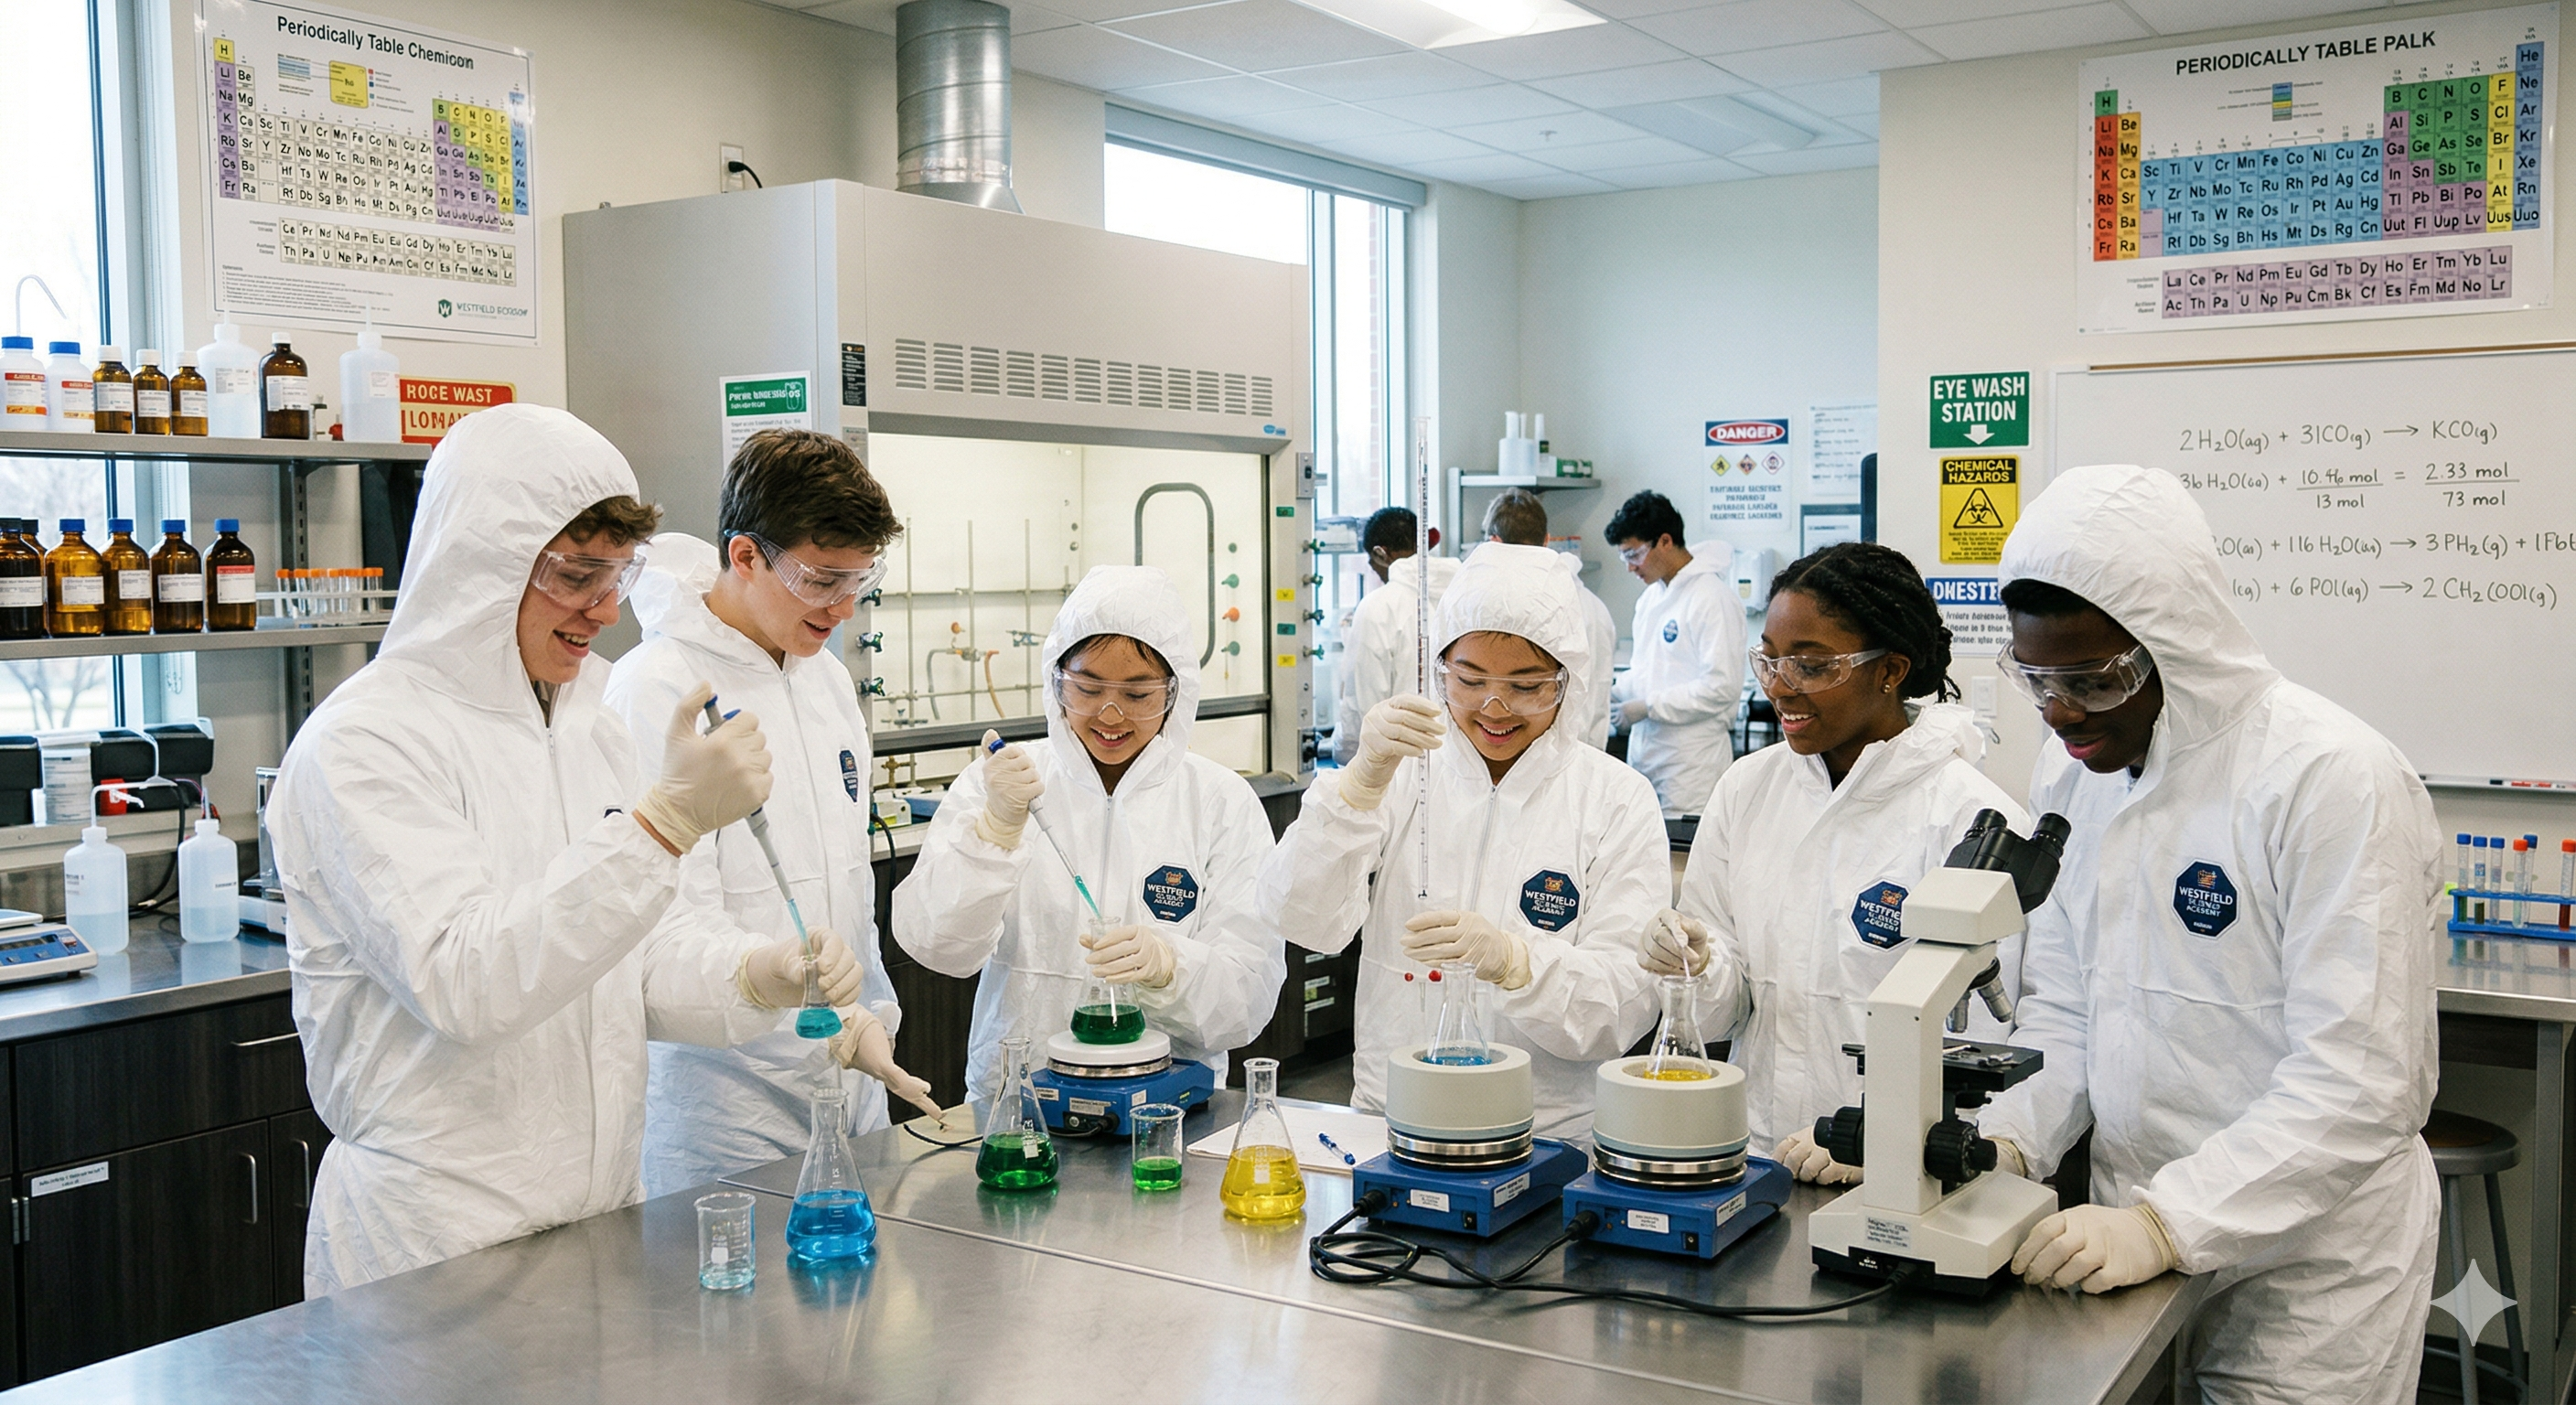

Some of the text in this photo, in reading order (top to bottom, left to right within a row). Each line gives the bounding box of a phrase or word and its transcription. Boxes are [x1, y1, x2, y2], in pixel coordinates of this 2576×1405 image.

[278, 16, 363, 49] Periodically
[368, 34, 404, 55] Table
[221, 45, 228, 55] H
[2176, 31, 2435, 75] PERIODICALLY TABLE PALK
[239, 71, 251, 81] Be
[2102, 50, 2538, 107] H He
[220, 90, 252, 106] Na Mg
[2121, 77, 2538, 131] Be B C N O F Ne
[223, 113, 327, 137] K Ti V Cr
[2098, 103, 2536, 156] Na Mg Al Si P S Cl Ar
[242, 139, 346, 161] Sr Y Zr Mo Tc
[2102, 130, 2536, 180] K Ca Sc Ti V Cr Mn Fe Co Ni Cu Zn Br Kr
[318, 170, 328, 180] W
[2098, 156, 2536, 205] Rb Sr Y Zr Nb Mo Tc Ru Rh Pd Ag Cd Sn Xe
[225, 181, 255, 193] Fr Ra
[2098, 182, 2536, 229] Cs Ba Hf Ta W Re Os Ir Pt Au Hg Pb Bi Po At Rn
[303, 227, 313, 236] Pr
[2099, 222, 2377, 253] Fr Ra Db Sg Bh Hs Mt Ds Rg Cn
[284, 246, 329, 259] Th Pa U
[2215, 253, 2506, 284] Pr Eu Ho Er Yb Lu
[2240, 279, 2505, 306] U Pu Lr
[440, 304, 450, 315] W
[454, 387, 492, 403] WAST
[1934, 376, 2025, 400] EYE WASH
[1941, 401, 2016, 423] STATION
[1716, 426, 1777, 440] DANGER
[1946, 460, 2012, 472] CHEMICAL
[2349, 468, 2378, 483] mol
[2426, 462, 2467, 480] 2.33
[2475, 461, 2508, 477] mol
[1948, 472, 2009, 483] HAZARDS
[2317, 493, 2365, 509] 13 mol
[2442, 489, 2506, 507] 73 mol
[2179, 886, 2233, 905] WESTFIELD
